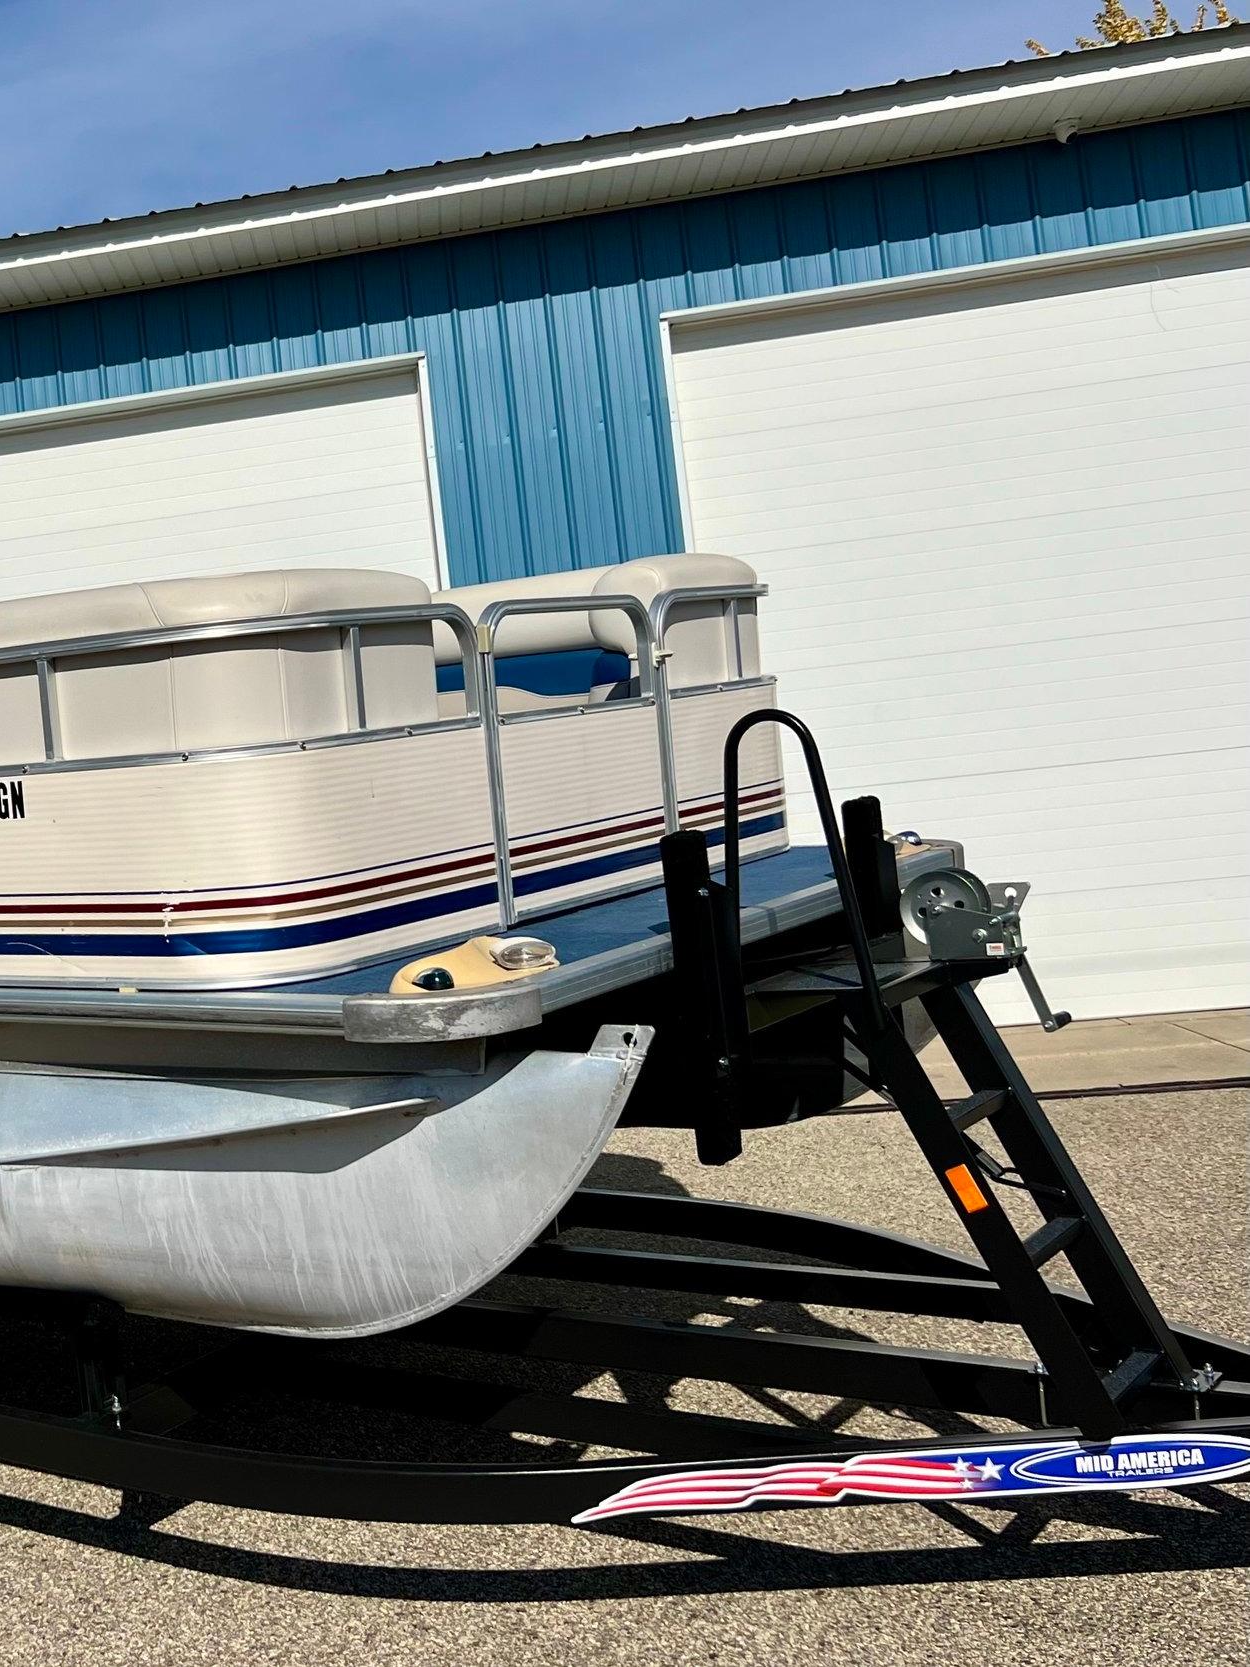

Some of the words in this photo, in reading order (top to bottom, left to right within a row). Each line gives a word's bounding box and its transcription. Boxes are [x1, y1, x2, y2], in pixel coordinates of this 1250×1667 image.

[1075, 1454, 1115, 1473] MID
[1117, 1448, 1205, 1471] AMERICA
[1106, 1466, 1174, 1478] TRAILERS
